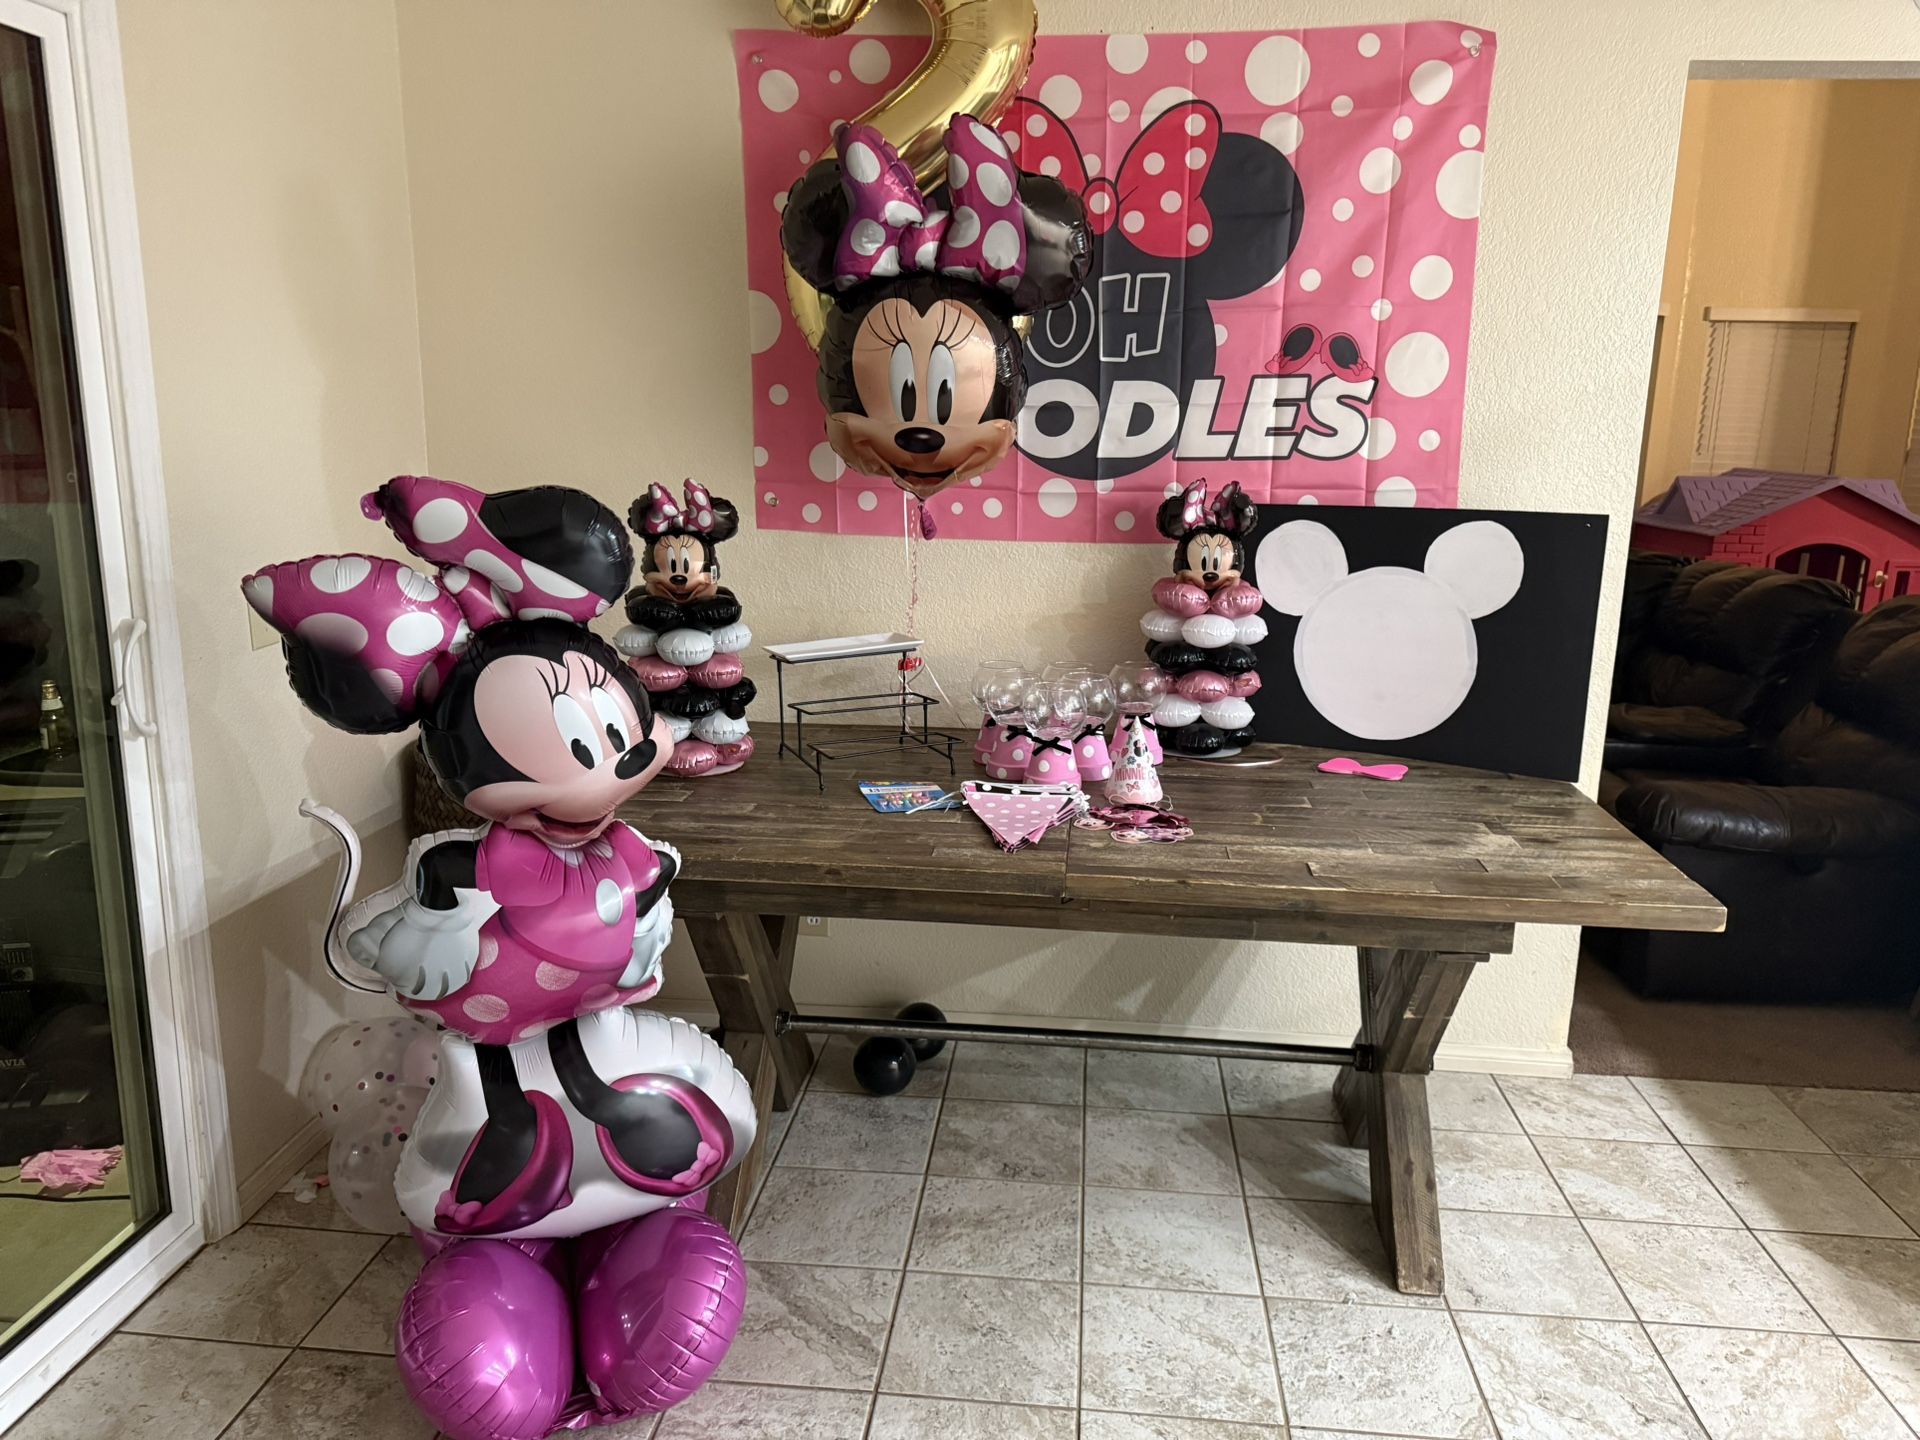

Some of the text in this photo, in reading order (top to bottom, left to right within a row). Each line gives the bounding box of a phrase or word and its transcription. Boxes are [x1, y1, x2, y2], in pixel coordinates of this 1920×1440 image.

[1027, 271, 1171, 368] OH
[1015, 374, 1378, 461] ODLES
[1114, 766, 1145, 782] MINNIE
